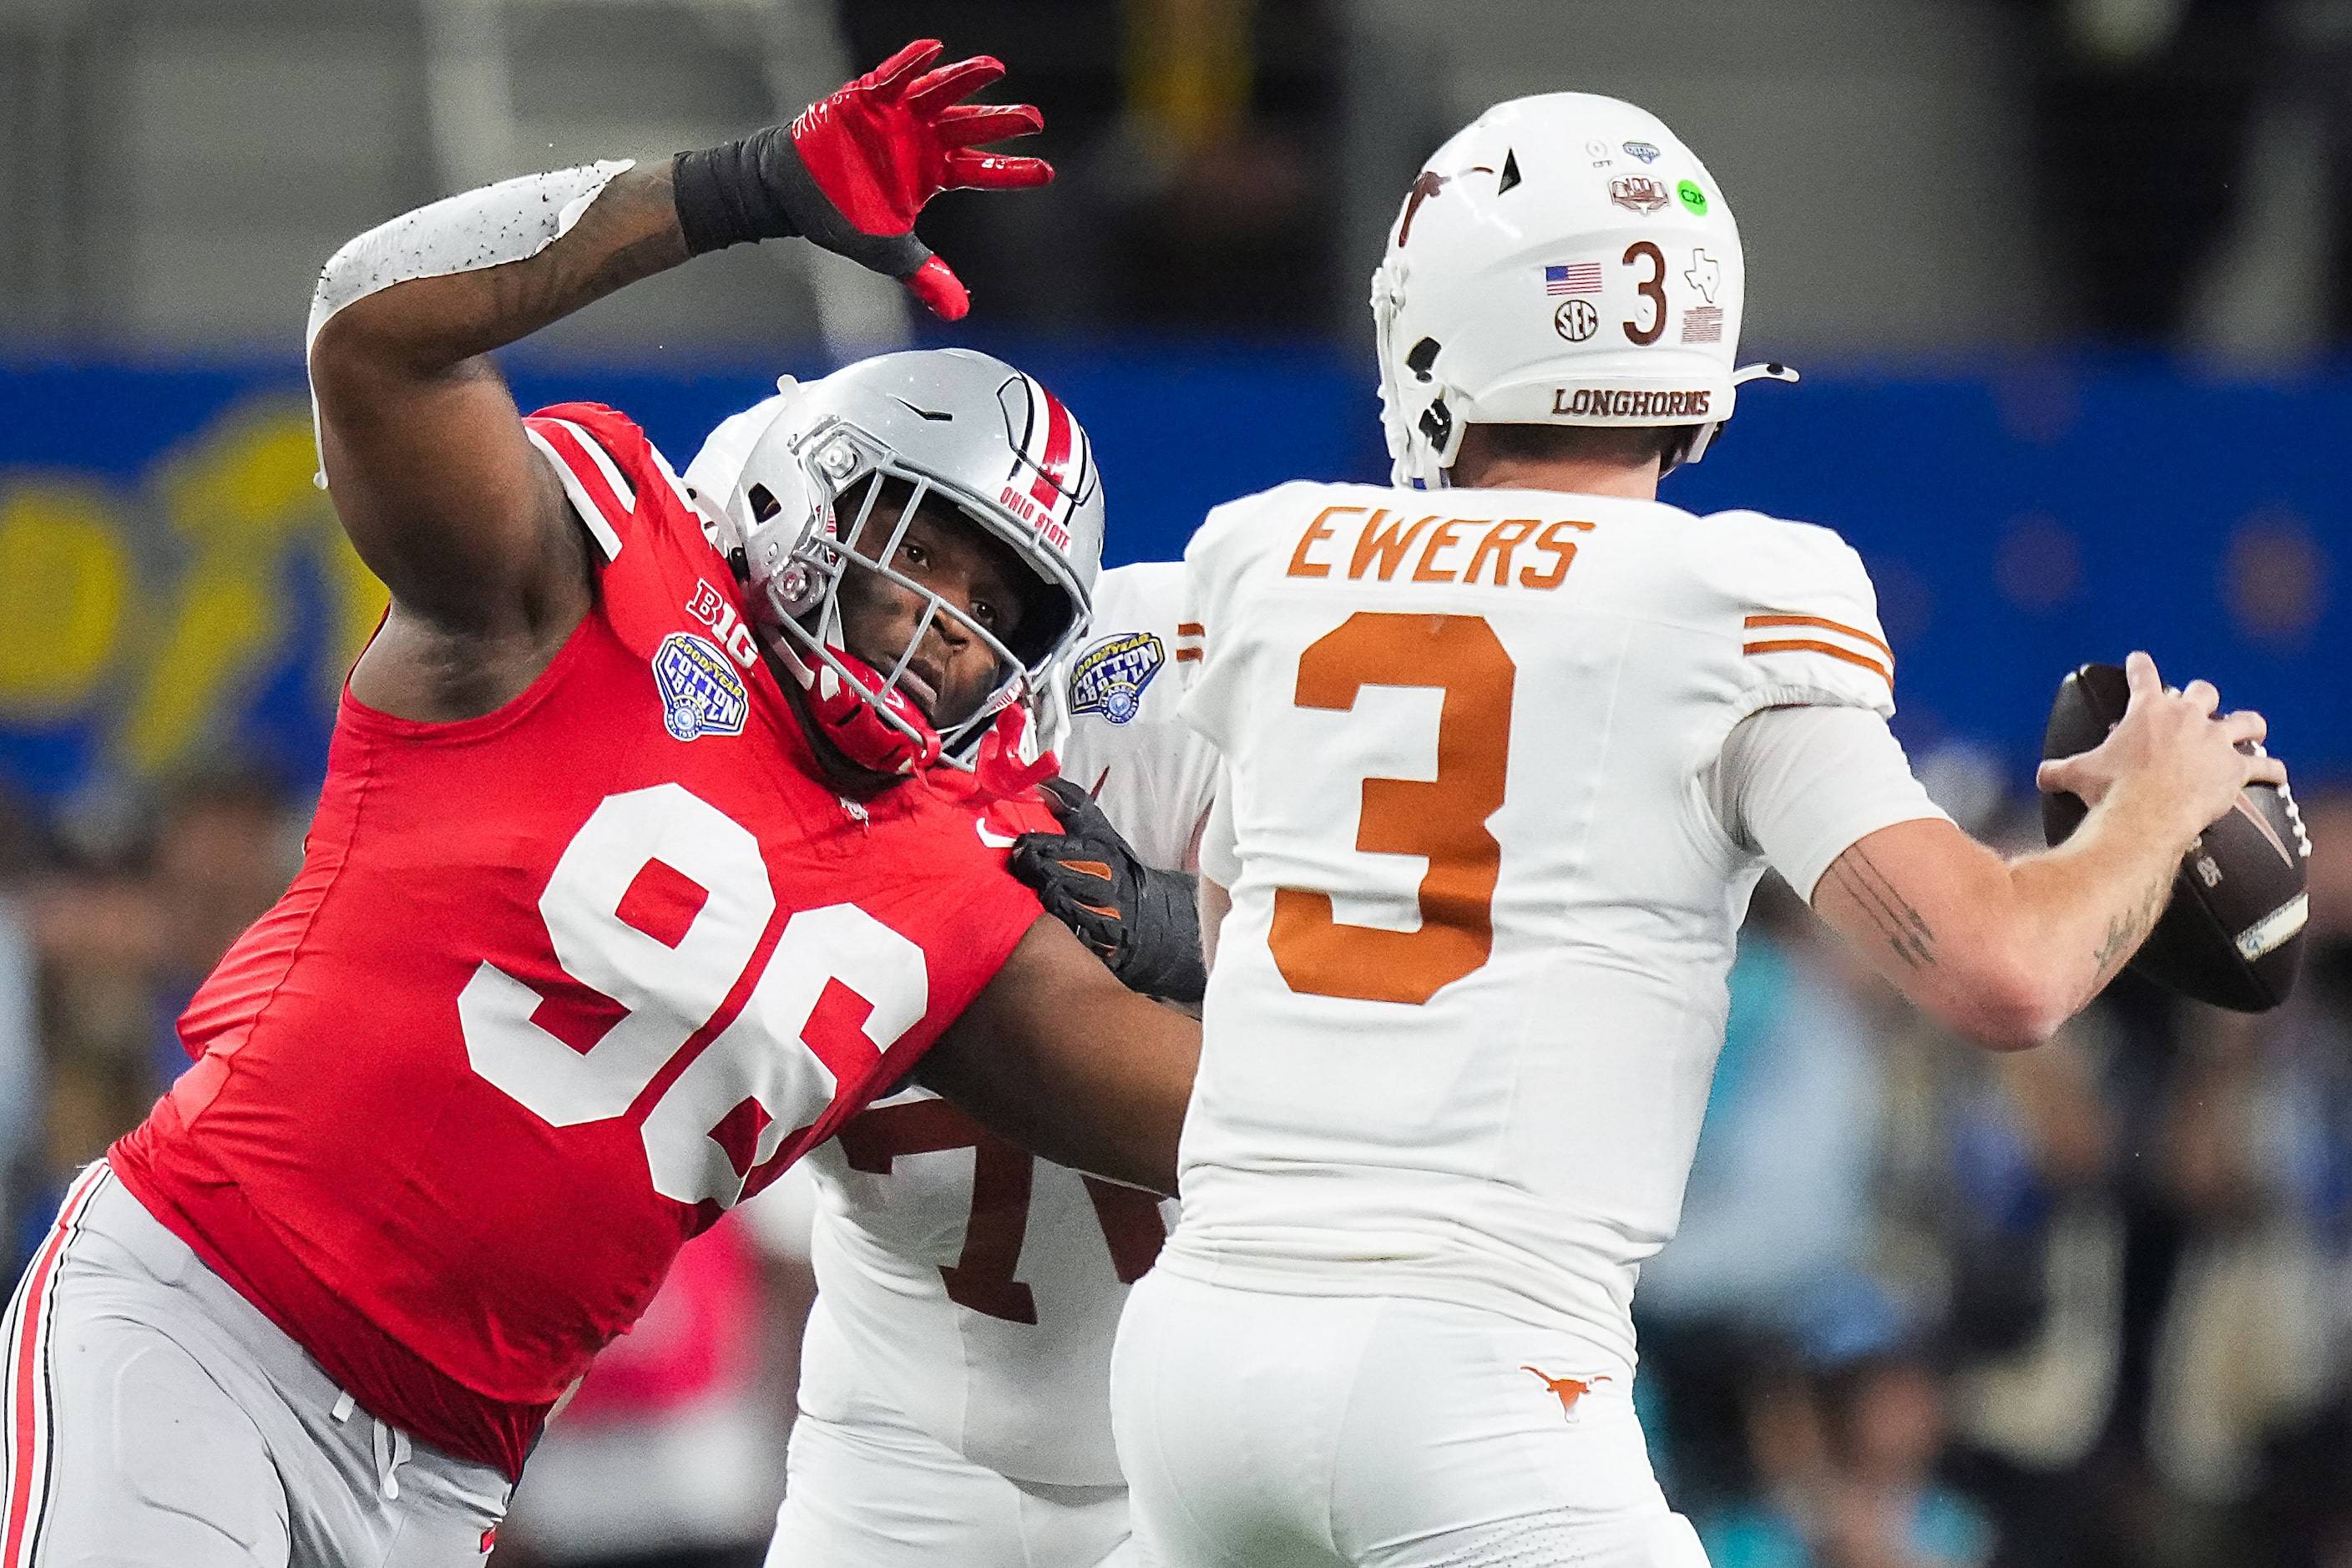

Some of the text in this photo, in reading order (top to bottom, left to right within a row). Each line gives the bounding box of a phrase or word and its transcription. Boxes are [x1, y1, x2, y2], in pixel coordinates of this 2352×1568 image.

[1555, 300, 1598, 341] SEC
[1621, 241, 1667, 346] 3
[1552, 389, 1711, 417] LONGHORNS
[1000, 487, 1071, 551] OHIO STATE
[1287, 506, 1596, 590] EWERS
[664, 647, 741, 724] COTTON
[671, 673, 721, 721] BOWL
[675, 637, 743, 698] GOODYEAR
[1075, 642, 1158, 704] COTTON
[1085, 668, 1145, 701] BOWL
[1267, 611, 1516, 1005] 3
[457, 782, 928, 1211] 96
[835, 1097, 1169, 1326] 7
